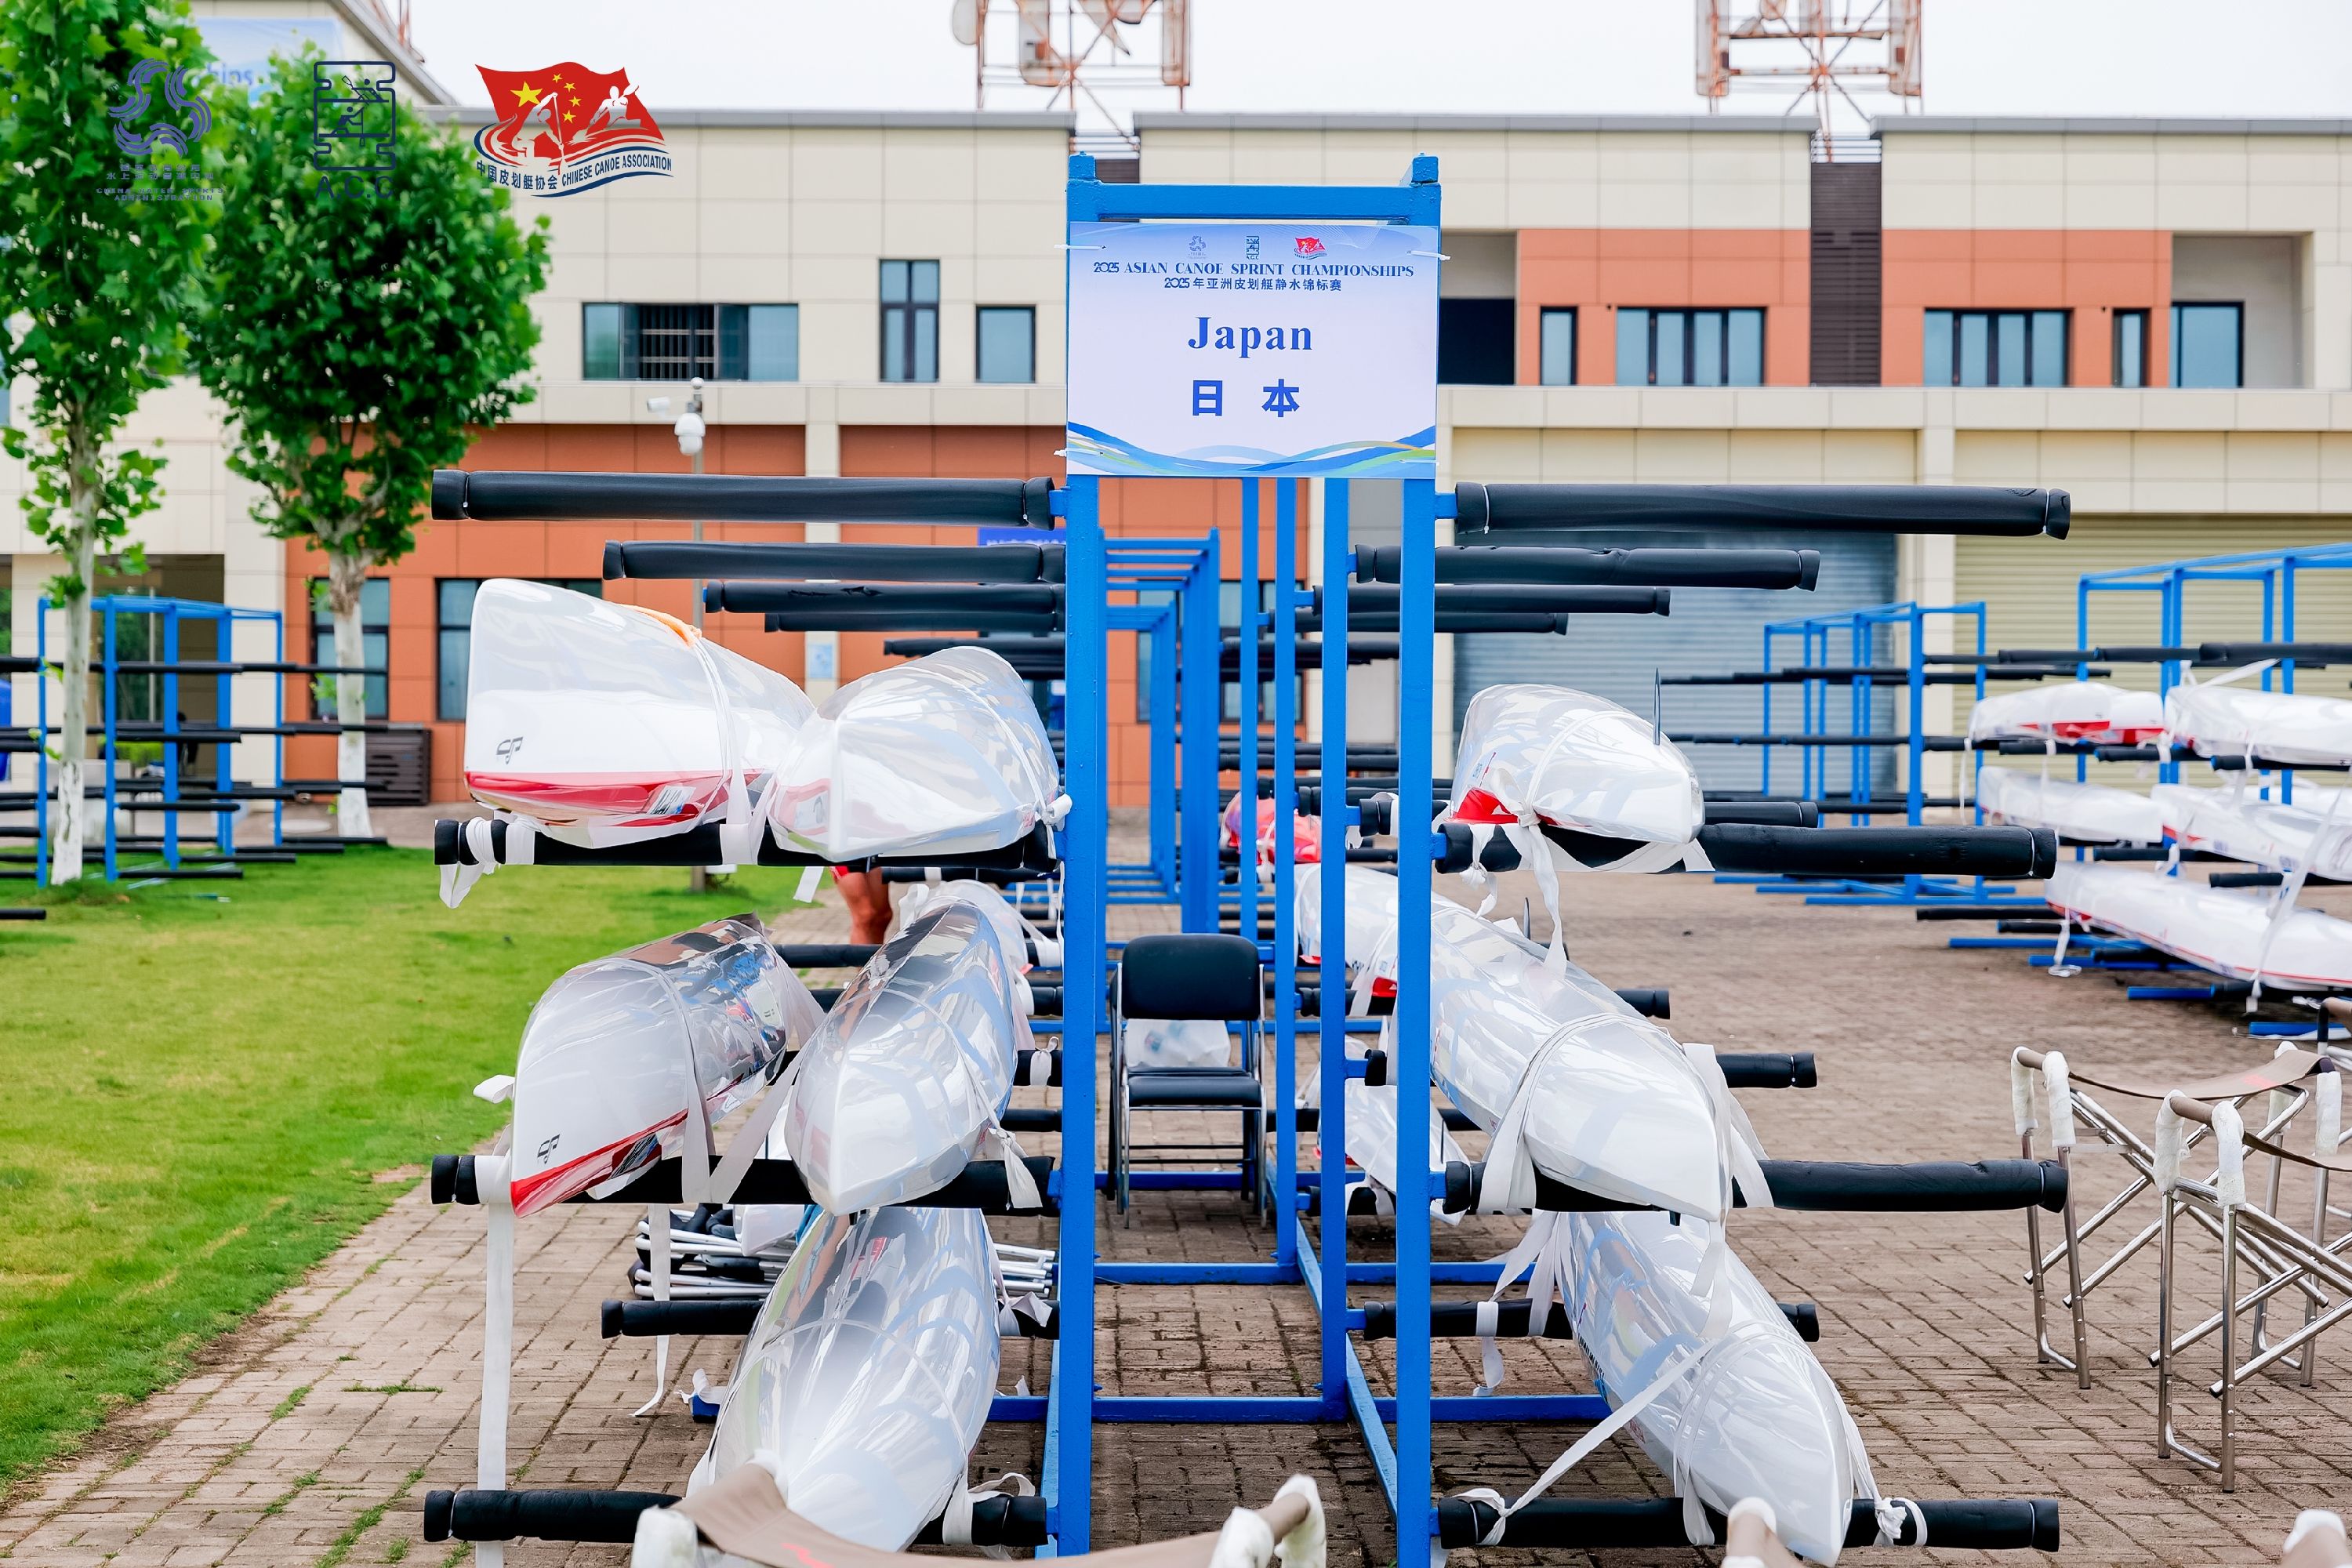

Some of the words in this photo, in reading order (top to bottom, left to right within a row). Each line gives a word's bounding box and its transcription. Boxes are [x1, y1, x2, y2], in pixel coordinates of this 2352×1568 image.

[1094, 262, 1120, 274] 2025
[1124, 262, 1168, 274] ASIAN
[1175, 263, 1224, 274] CANOE
[1231, 263, 1284, 275] SPRINT
[1292, 264, 1414, 277] CHAMPIONSHIPS
[1188, 317, 1312, 359] Japan
